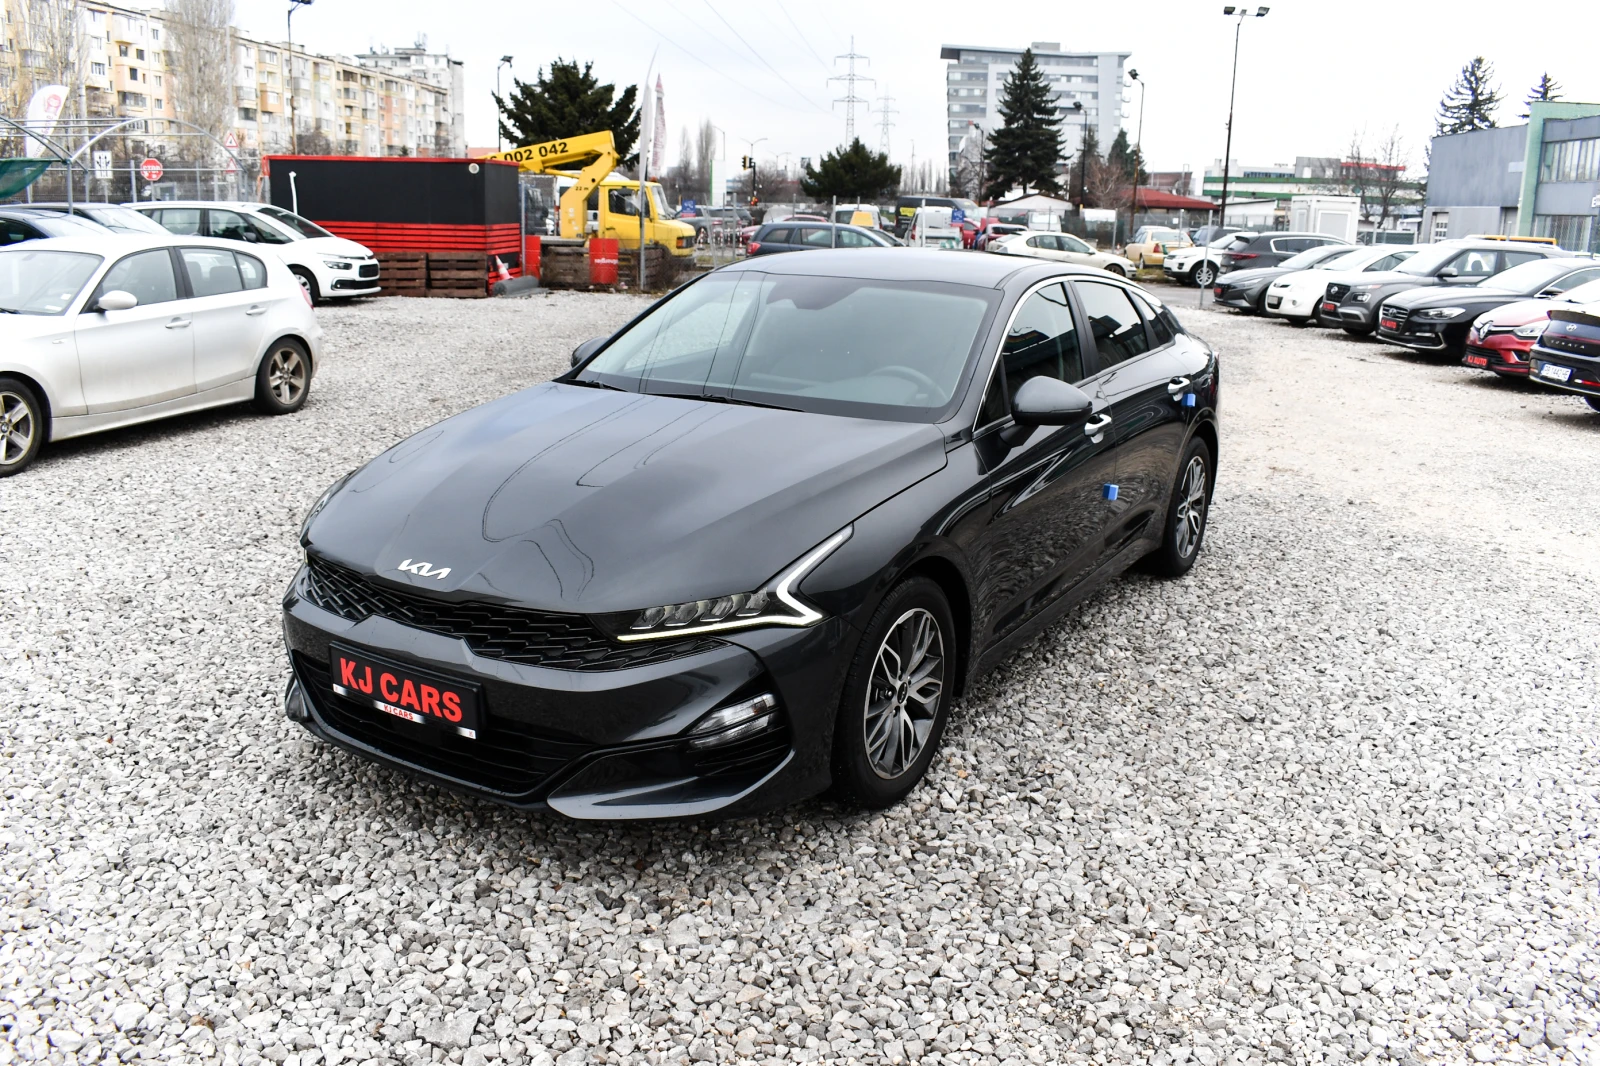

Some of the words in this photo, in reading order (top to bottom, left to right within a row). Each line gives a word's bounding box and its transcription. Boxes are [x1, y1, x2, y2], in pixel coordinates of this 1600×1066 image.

[504, 149, 534, 162] 002
[539, 142, 569, 158] 042
[143, 165, 161, 173] STOP
[1551, 339, 1585, 349] SONATA
[1474, 357, 1487, 366] AUTO
[340, 657, 373, 694] KJ
[379, 672, 463, 723] CARS
[393, 707, 414, 720] CARS
